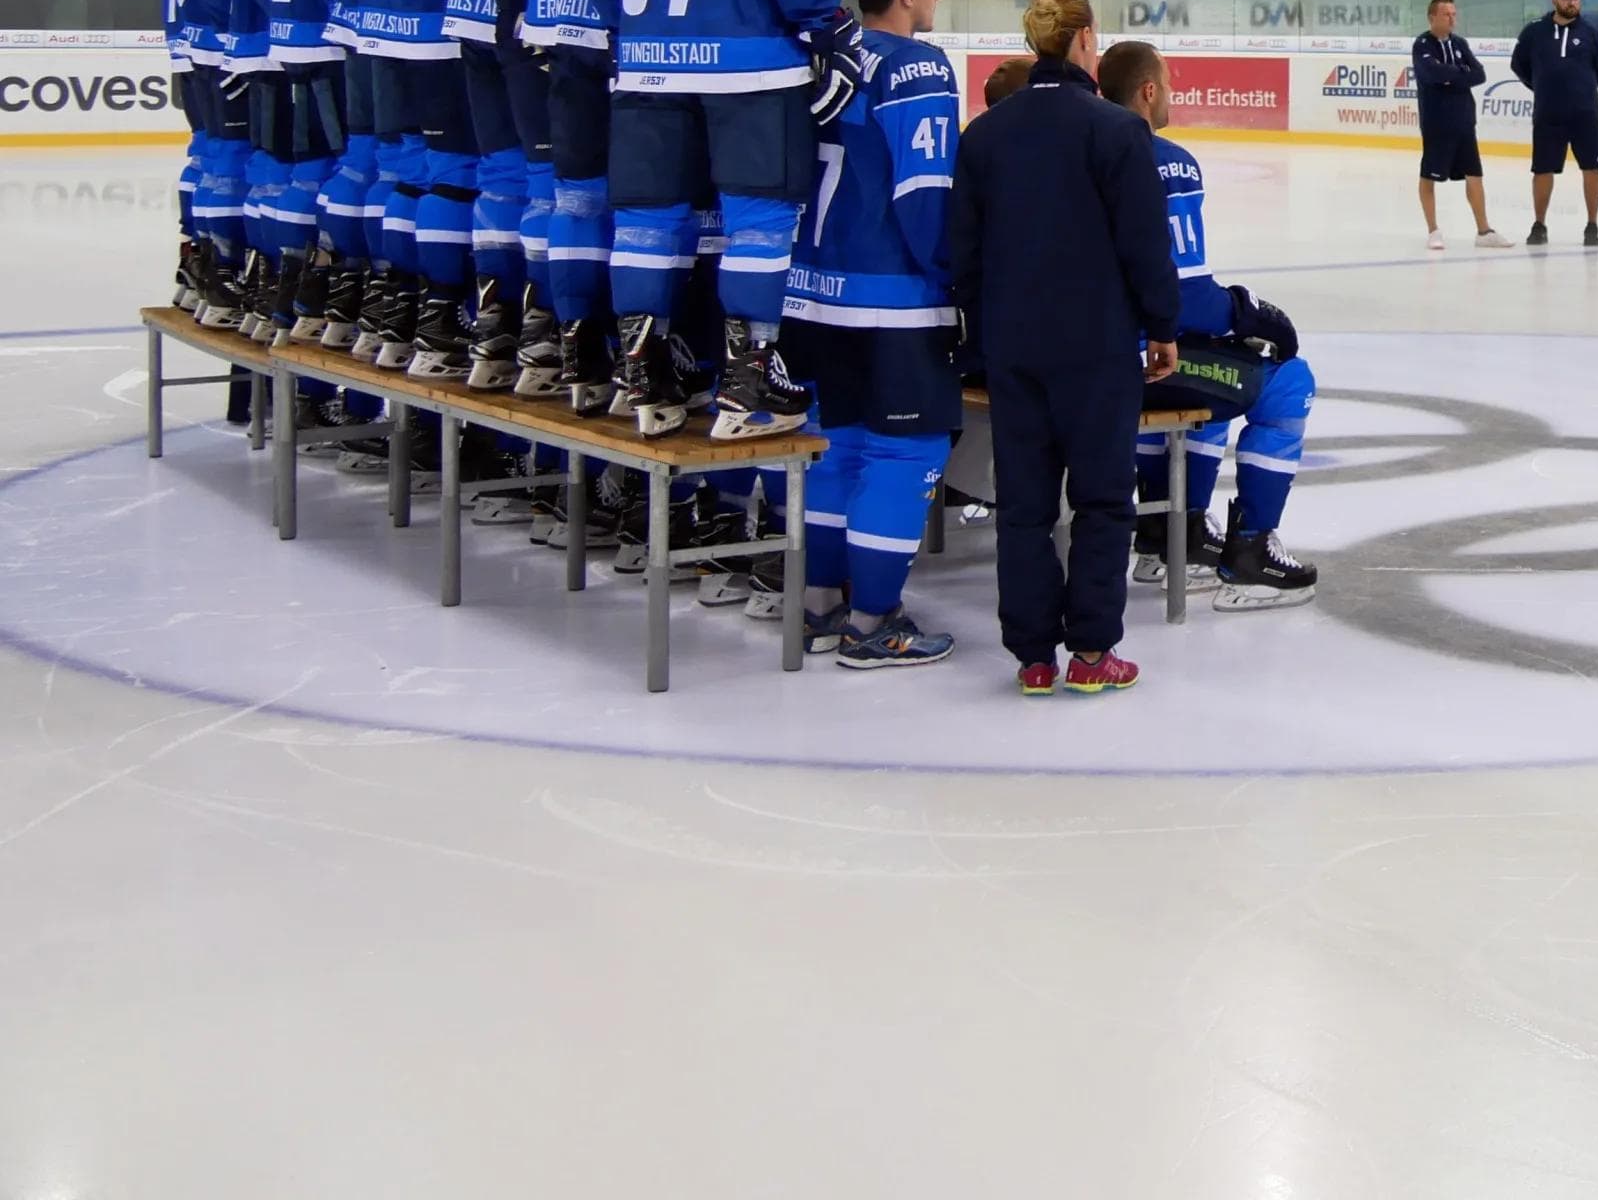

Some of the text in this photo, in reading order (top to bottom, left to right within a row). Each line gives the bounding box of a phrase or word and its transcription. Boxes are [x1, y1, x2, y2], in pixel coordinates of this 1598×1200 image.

[49, 35, 80, 43] Audi
[1338, 65, 1387, 87] Pollin
[1206, 86, 1277, 109] Eichstätt
[1482, 98, 1533, 117] FUTUR
[1338, 105, 1418, 129] www.pollin
[912, 117, 950, 160] 47
[1158, 162, 1200, 181] RBUS
